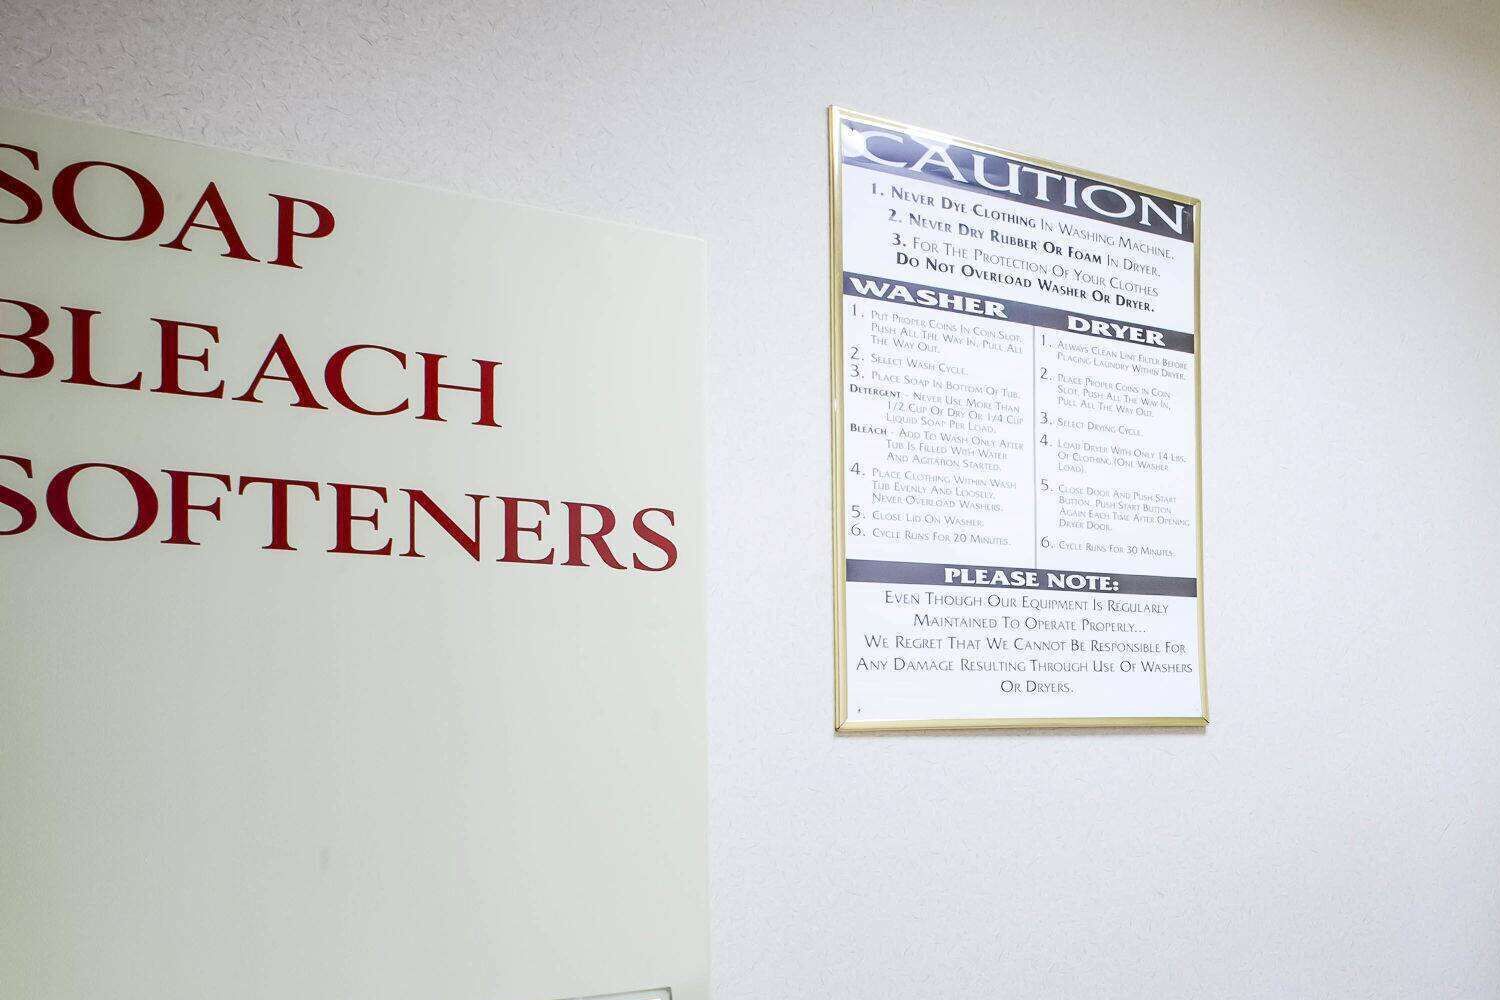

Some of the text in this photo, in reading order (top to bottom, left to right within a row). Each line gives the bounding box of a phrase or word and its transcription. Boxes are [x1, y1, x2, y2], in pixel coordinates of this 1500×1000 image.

[864, 130, 1186, 235] CAUTION
[0, 144, 335, 268] SOAP
[872, 181, 1174, 259] 1. NEVER DYE CLOTHING IN WASHING MACHINE.
[888, 208, 1160, 276] 2. NEVER DRY RUBBER OR FOAM IN DRYER.
[891, 232, 1158, 296] 3. FOR THE PROTECTION OF YOUR CLOTHES
[896, 251, 1154, 311] DO NOT OVERLOAD WASHER OR DRYER.
[849, 276, 1007, 319] WASHER
[852, 304, 863, 317] 1.
[1067, 315, 1165, 346] DRYER
[1042, 334, 1051, 347] 1.
[851, 346, 863, 360] 2.
[0, 299, 501, 427] BLEACH
[850, 364, 864, 378] 3.
[849, 383, 900, 398] DETERGENT
[1040, 411, 1052, 424] 3.
[850, 422, 886, 435] BLEACH
[0, 455, 677, 572] SOFTENERS
[851, 505, 865, 518] 5.
[850, 523, 865, 536] 6.
[1041, 536, 1053, 548] 6.
[944, 566, 1118, 591] PLEASE NOTE:
[885, 590, 1168, 614] EVEN THOUGH OUR EQUIPMENT IS REGULARLY
[913, 613, 1146, 632] MAINTAINED TO OPERATE PROPERLY...
[864, 634, 1186, 653] WE REGRET THAT WE CANNOT BE RESPONSIBLE FOR
[856, 657, 1192, 673] ANY DAMAGE RESULTING THROUGH USE OF WASHERS
[1000, 680, 1073, 692] OR DRYERS.
